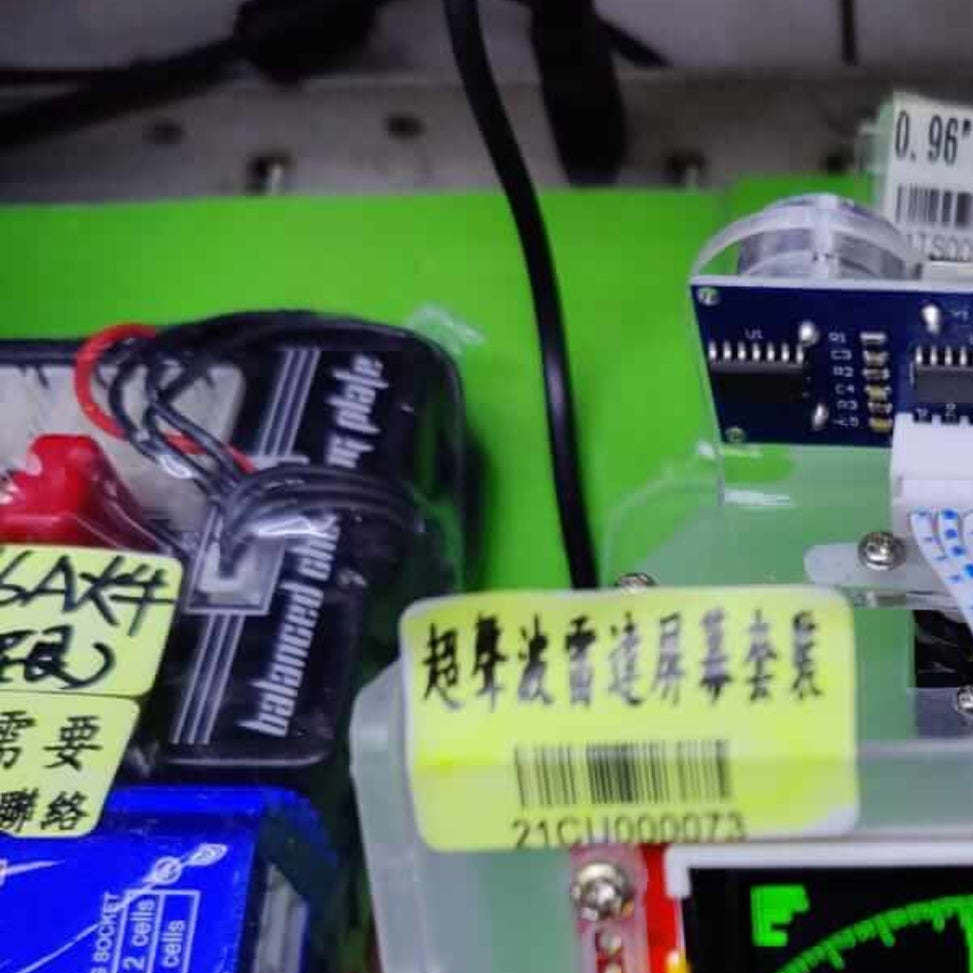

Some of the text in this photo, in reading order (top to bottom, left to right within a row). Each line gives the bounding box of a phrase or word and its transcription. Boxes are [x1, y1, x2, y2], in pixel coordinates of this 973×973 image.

[234, 580, 323, 737] balanced
[94, 891, 119, 963] SOCKET
[123, 899, 155, 971] 2 cells
[161, 918, 185, 968] cells
